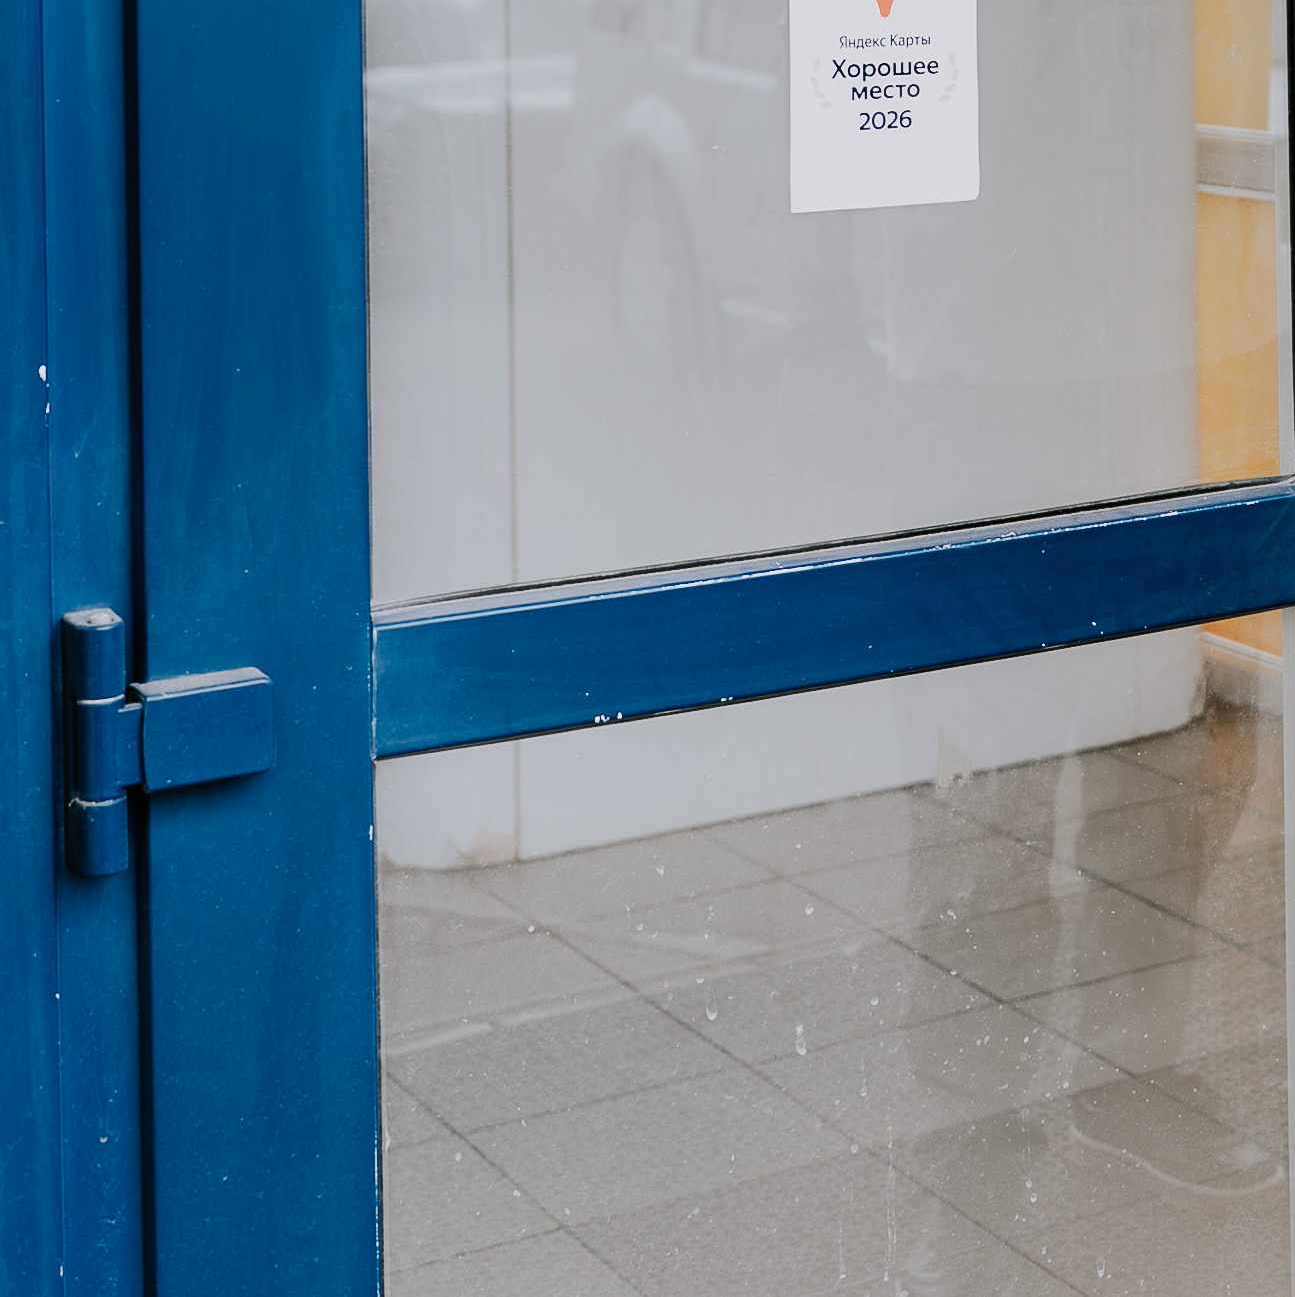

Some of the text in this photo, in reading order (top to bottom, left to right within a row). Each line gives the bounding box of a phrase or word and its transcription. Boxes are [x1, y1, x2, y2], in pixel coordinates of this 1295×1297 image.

[840, 34, 930, 49] Яндекс Карты
[832, 59, 938, 81] Хорошее
[852, 84, 920, 100] место
[860, 110, 912, 130] 2026
